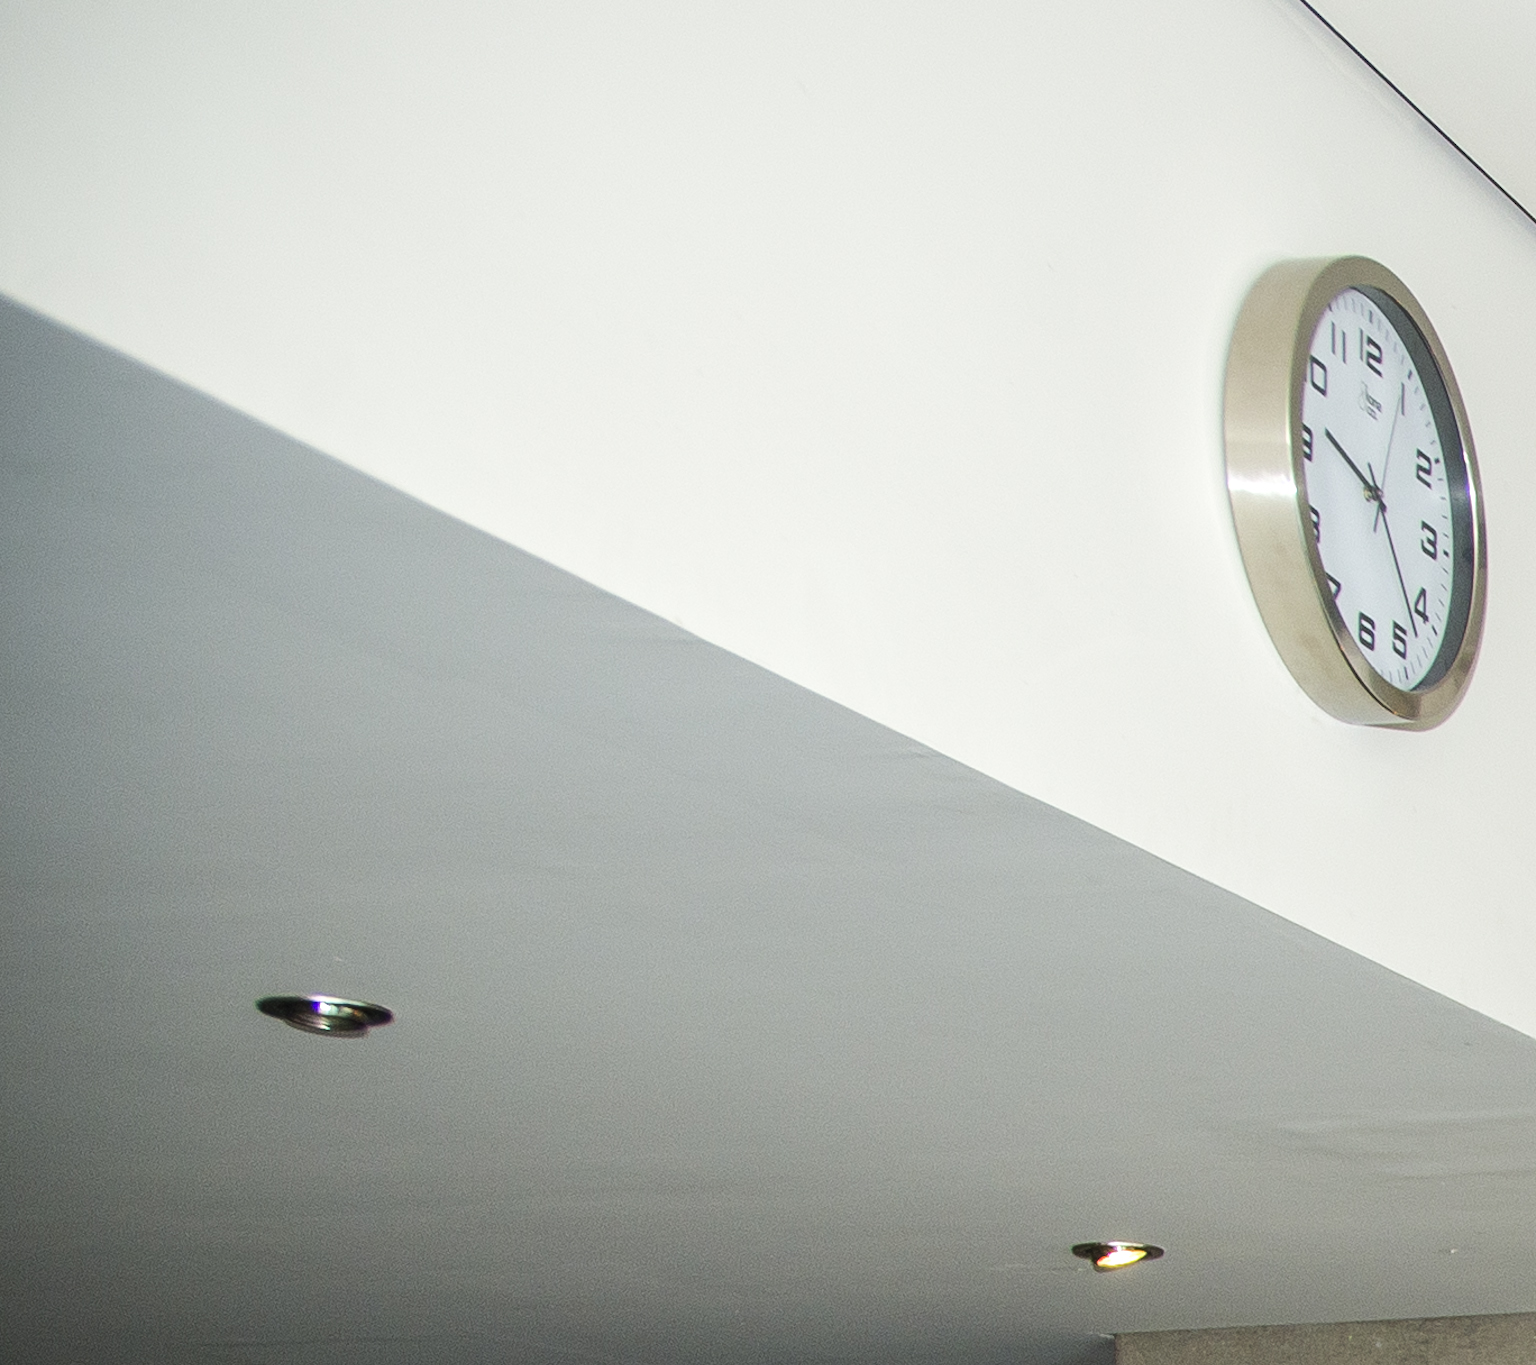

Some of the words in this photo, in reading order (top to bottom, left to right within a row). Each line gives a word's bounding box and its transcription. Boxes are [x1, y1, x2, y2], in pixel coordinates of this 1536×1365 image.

[1359, 327, 1383, 378] 12
[1416, 447, 1432, 490] 2
[1421, 520, 1437, 560] 3
[1414, 587, 1430, 625] 4
[1359, 611, 1375, 651] 6
[1393, 619, 1408, 660] 5
